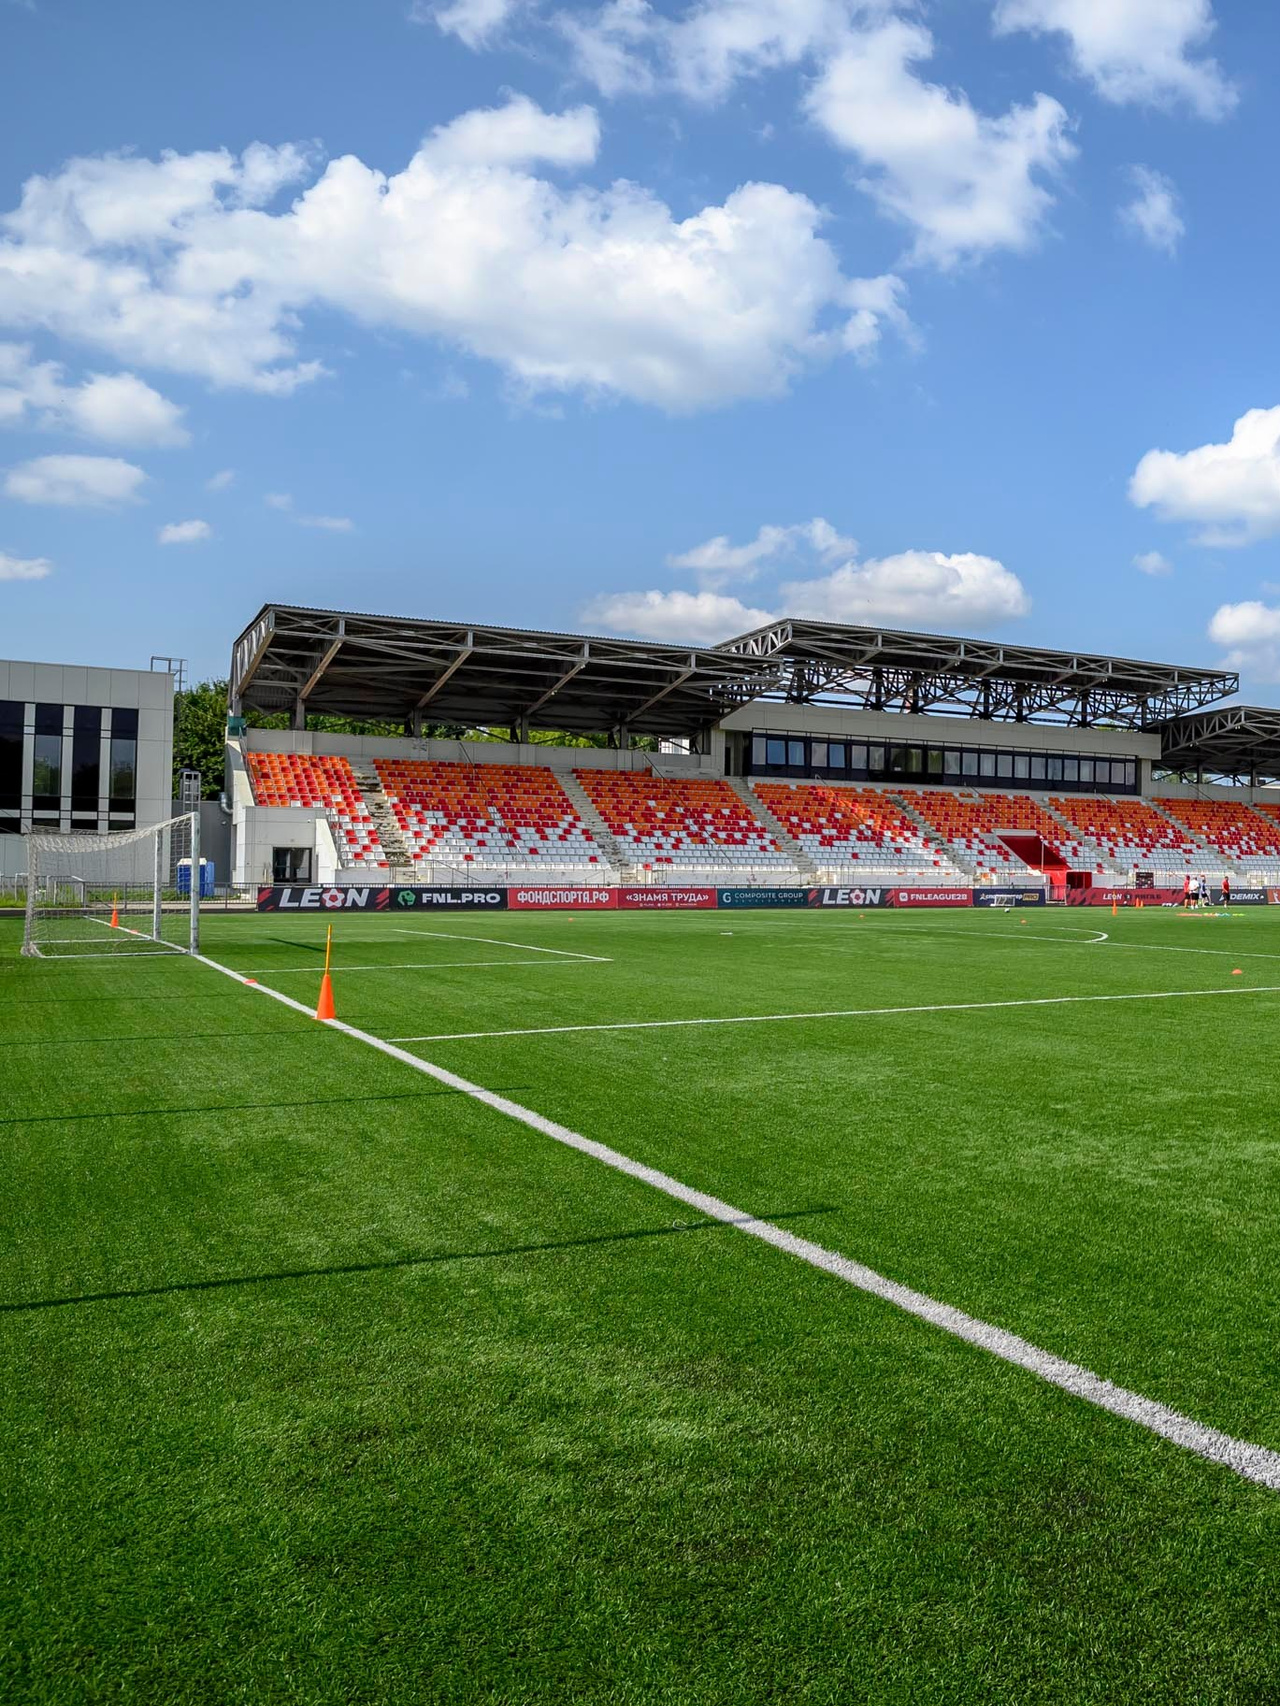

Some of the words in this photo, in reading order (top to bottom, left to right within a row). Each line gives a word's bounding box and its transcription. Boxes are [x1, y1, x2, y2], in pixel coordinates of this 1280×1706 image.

[279, 888, 370, 908] LEON
[422, 893, 501, 904] FNL.PRO
[517, 891, 609, 904] ФОНДСПОРТА.РФ
[626, 893, 668, 902] «ЗНАМЯ
[672, 893, 709, 903] ТРУДА»
[822, 889, 881, 905] LEON
